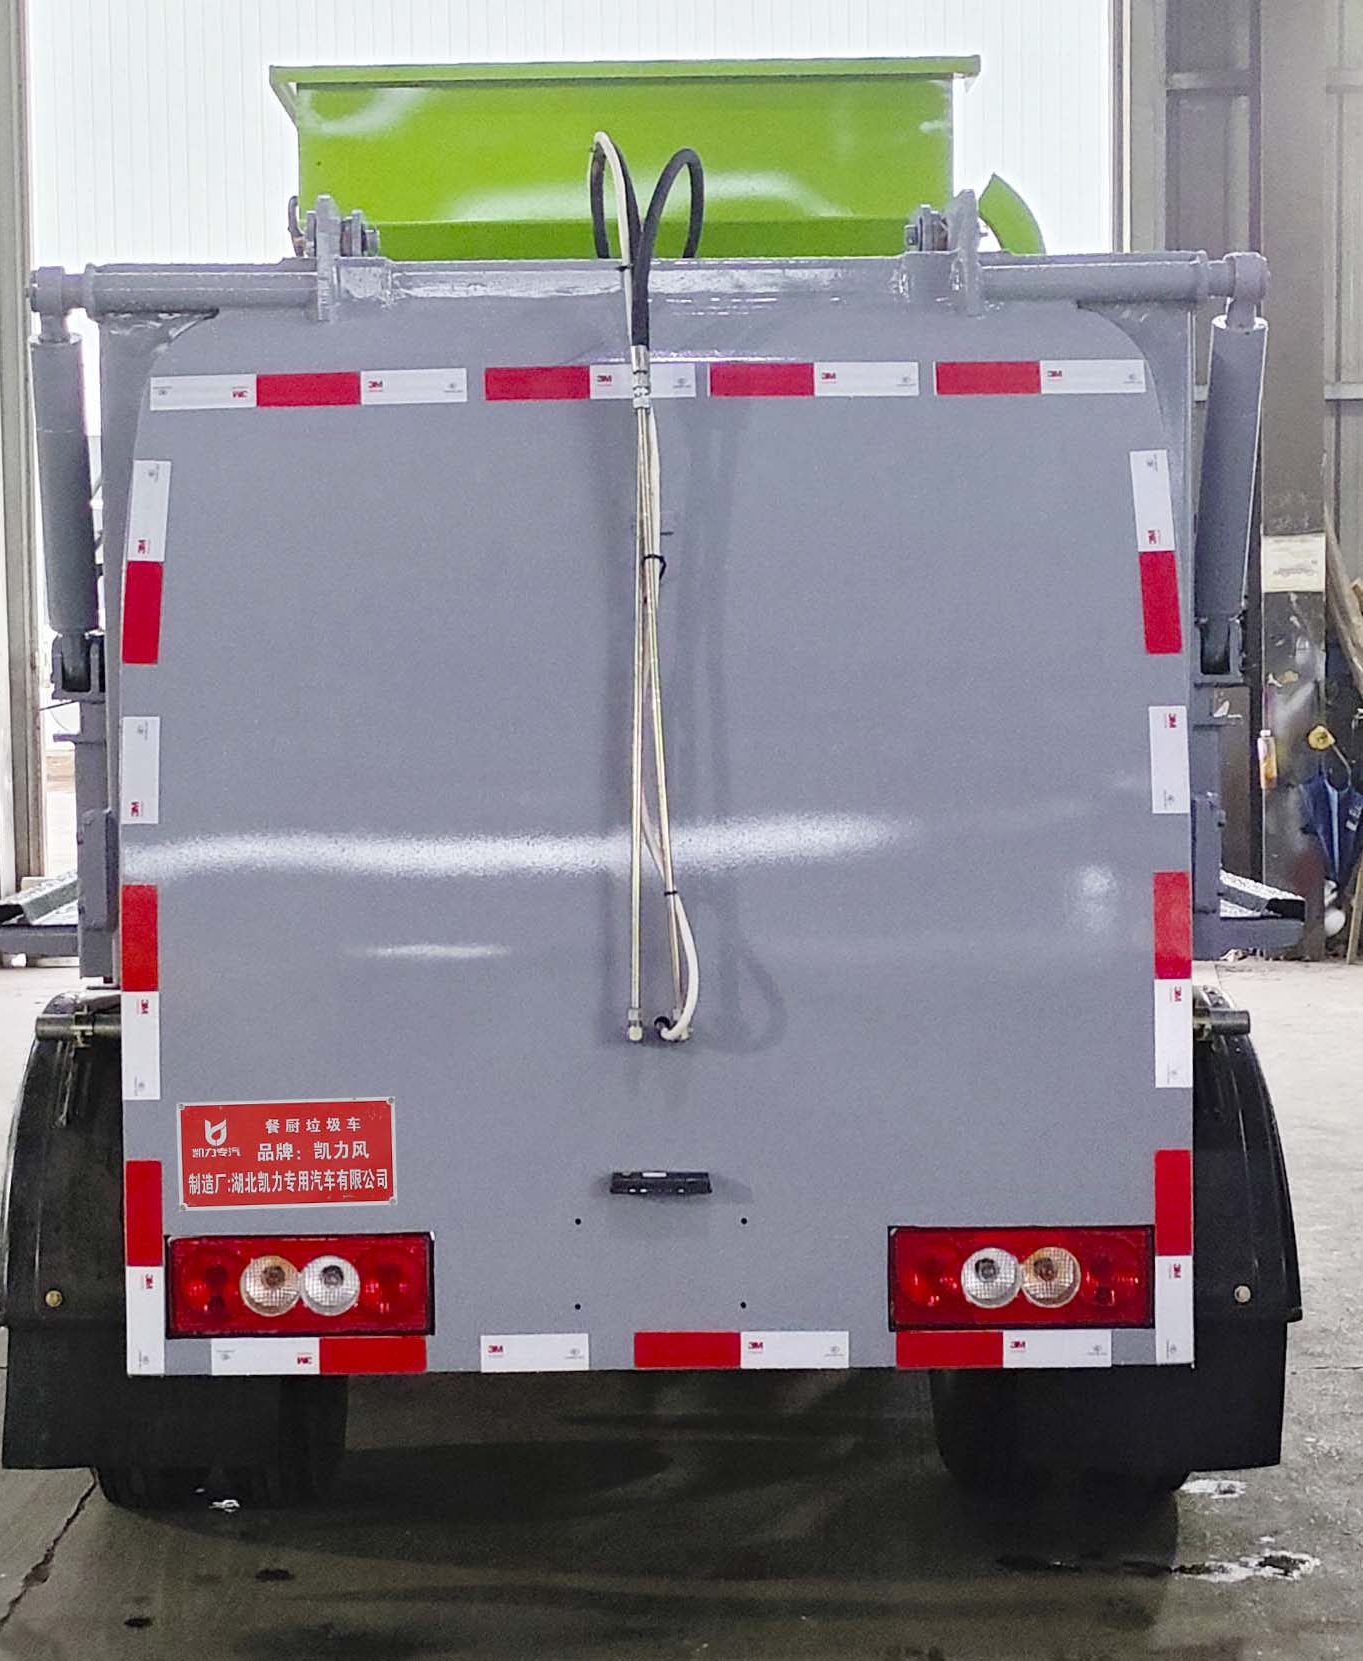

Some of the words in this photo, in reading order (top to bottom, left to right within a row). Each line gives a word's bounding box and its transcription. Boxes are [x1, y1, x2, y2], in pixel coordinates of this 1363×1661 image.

[265, 1116, 361, 1134] 餐厨垃圾车
[192, 1146, 241, 1158] 凯力专汽
[188, 1168, 389, 1196] 制造厂:湖北凯力专用汽车有限公司
